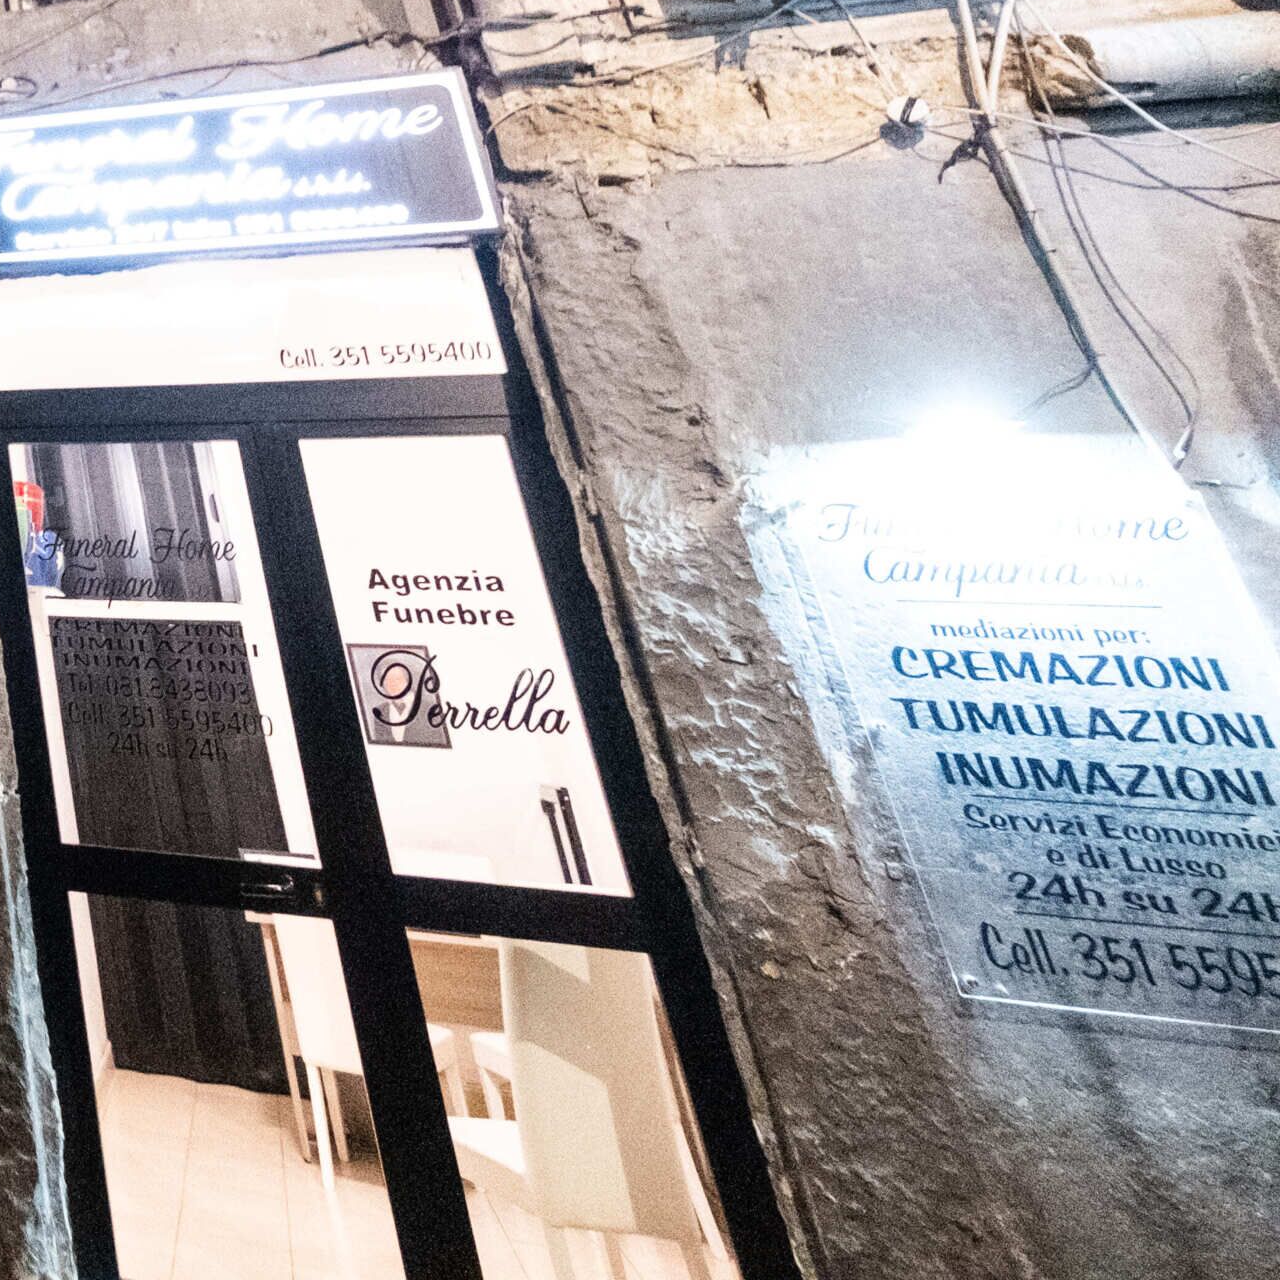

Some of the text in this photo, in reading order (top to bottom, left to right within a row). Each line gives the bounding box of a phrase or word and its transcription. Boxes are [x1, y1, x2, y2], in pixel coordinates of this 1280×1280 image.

[214, 97, 444, 162] Home
[329, 346, 373, 368] 351
[380, 341, 493, 367] 5595400
[38, 526, 237, 564] Funeral Home
[60, 563, 178, 609] Campania
[368, 568, 506, 597] Agenzia
[371, 601, 516, 627] Funebre
[51, 634, 259, 658] TUMULAZIONI
[929, 618, 1152, 648] mediazioni per:
[63, 652, 250, 676] INUMAZIONI
[890, 645, 1232, 693] CREMAZIONI
[370, 649, 571, 735] Perrella
[118, 704, 156, 729] 351
[166, 706, 273, 737] 5595400
[889, 696, 1277, 751] TUMULAZIONI
[107, 731, 149, 758] 24h
[188, 737, 230, 763] 24h
[935, 751, 1279, 807] INUMAZIONI
[962, 803, 1090, 837] Servizi
[1045, 845, 1228, 880] e di Lusso
[1007, 871, 1107, 908] 24h
[1121, 889, 1180, 915] su
[980, 921, 1070, 976] Cell.
[1071, 931, 1158, 987] 351
